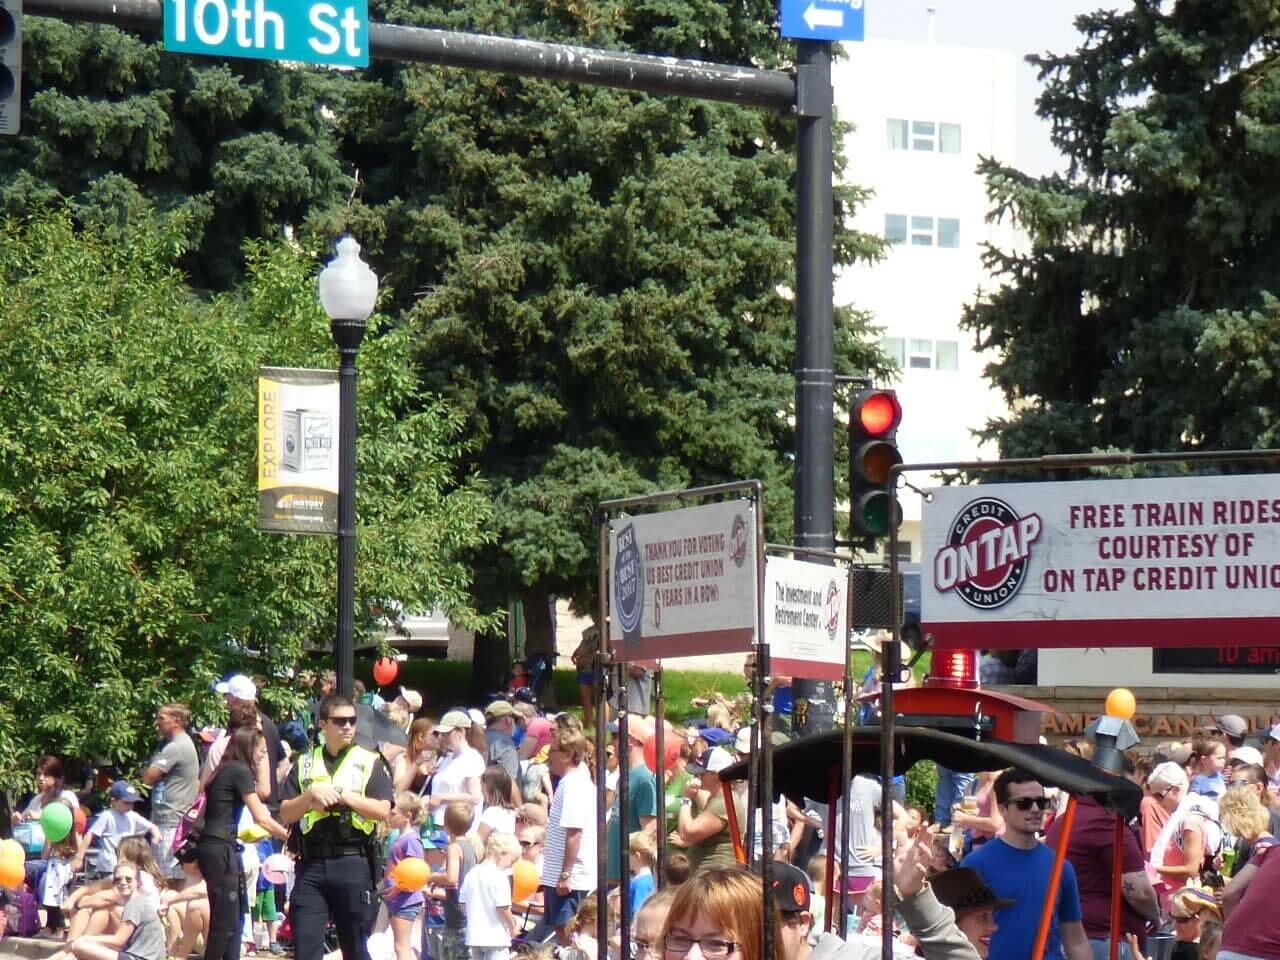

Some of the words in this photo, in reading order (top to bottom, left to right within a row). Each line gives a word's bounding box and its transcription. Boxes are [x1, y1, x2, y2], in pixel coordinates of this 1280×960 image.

[171, 0, 285, 50] 10th
[308, 2, 361, 57] St
[263, 391, 277, 478] EXPLORE
[955, 504, 1004, 534] CREDIT
[1069, 503, 1125, 529] FREE
[1131, 501, 1202, 527] TRAIN
[645, 541, 667, 561] THANK
[669, 538, 683, 558] YOU
[684, 536, 697, 556] FOR
[698, 532, 725, 555] VOTING
[1098, 533, 1218, 560] COURTESY
[1225, 532, 1255, 557] OF
[646, 566, 656, 585] US
[657, 564, 673, 584] BEST
[675, 560, 699, 581] CREDIT
[700, 558, 725, 579] UNION
[1043, 568, 1076, 593] ON
[1085, 566, 1127, 592] TAP
[1134, 565, 1216, 592] CREDIT
[662, 588, 682, 608] YEARS
[684, 586, 692, 605] IN
[775, 581, 784, 601] The
[785, 582, 812, 605] Investment
[813, 588, 822, 607] and
[973, 577, 1017, 603] UNION
[775, 604, 802, 625] Retirement
[1248, 648, 1280, 664] am
